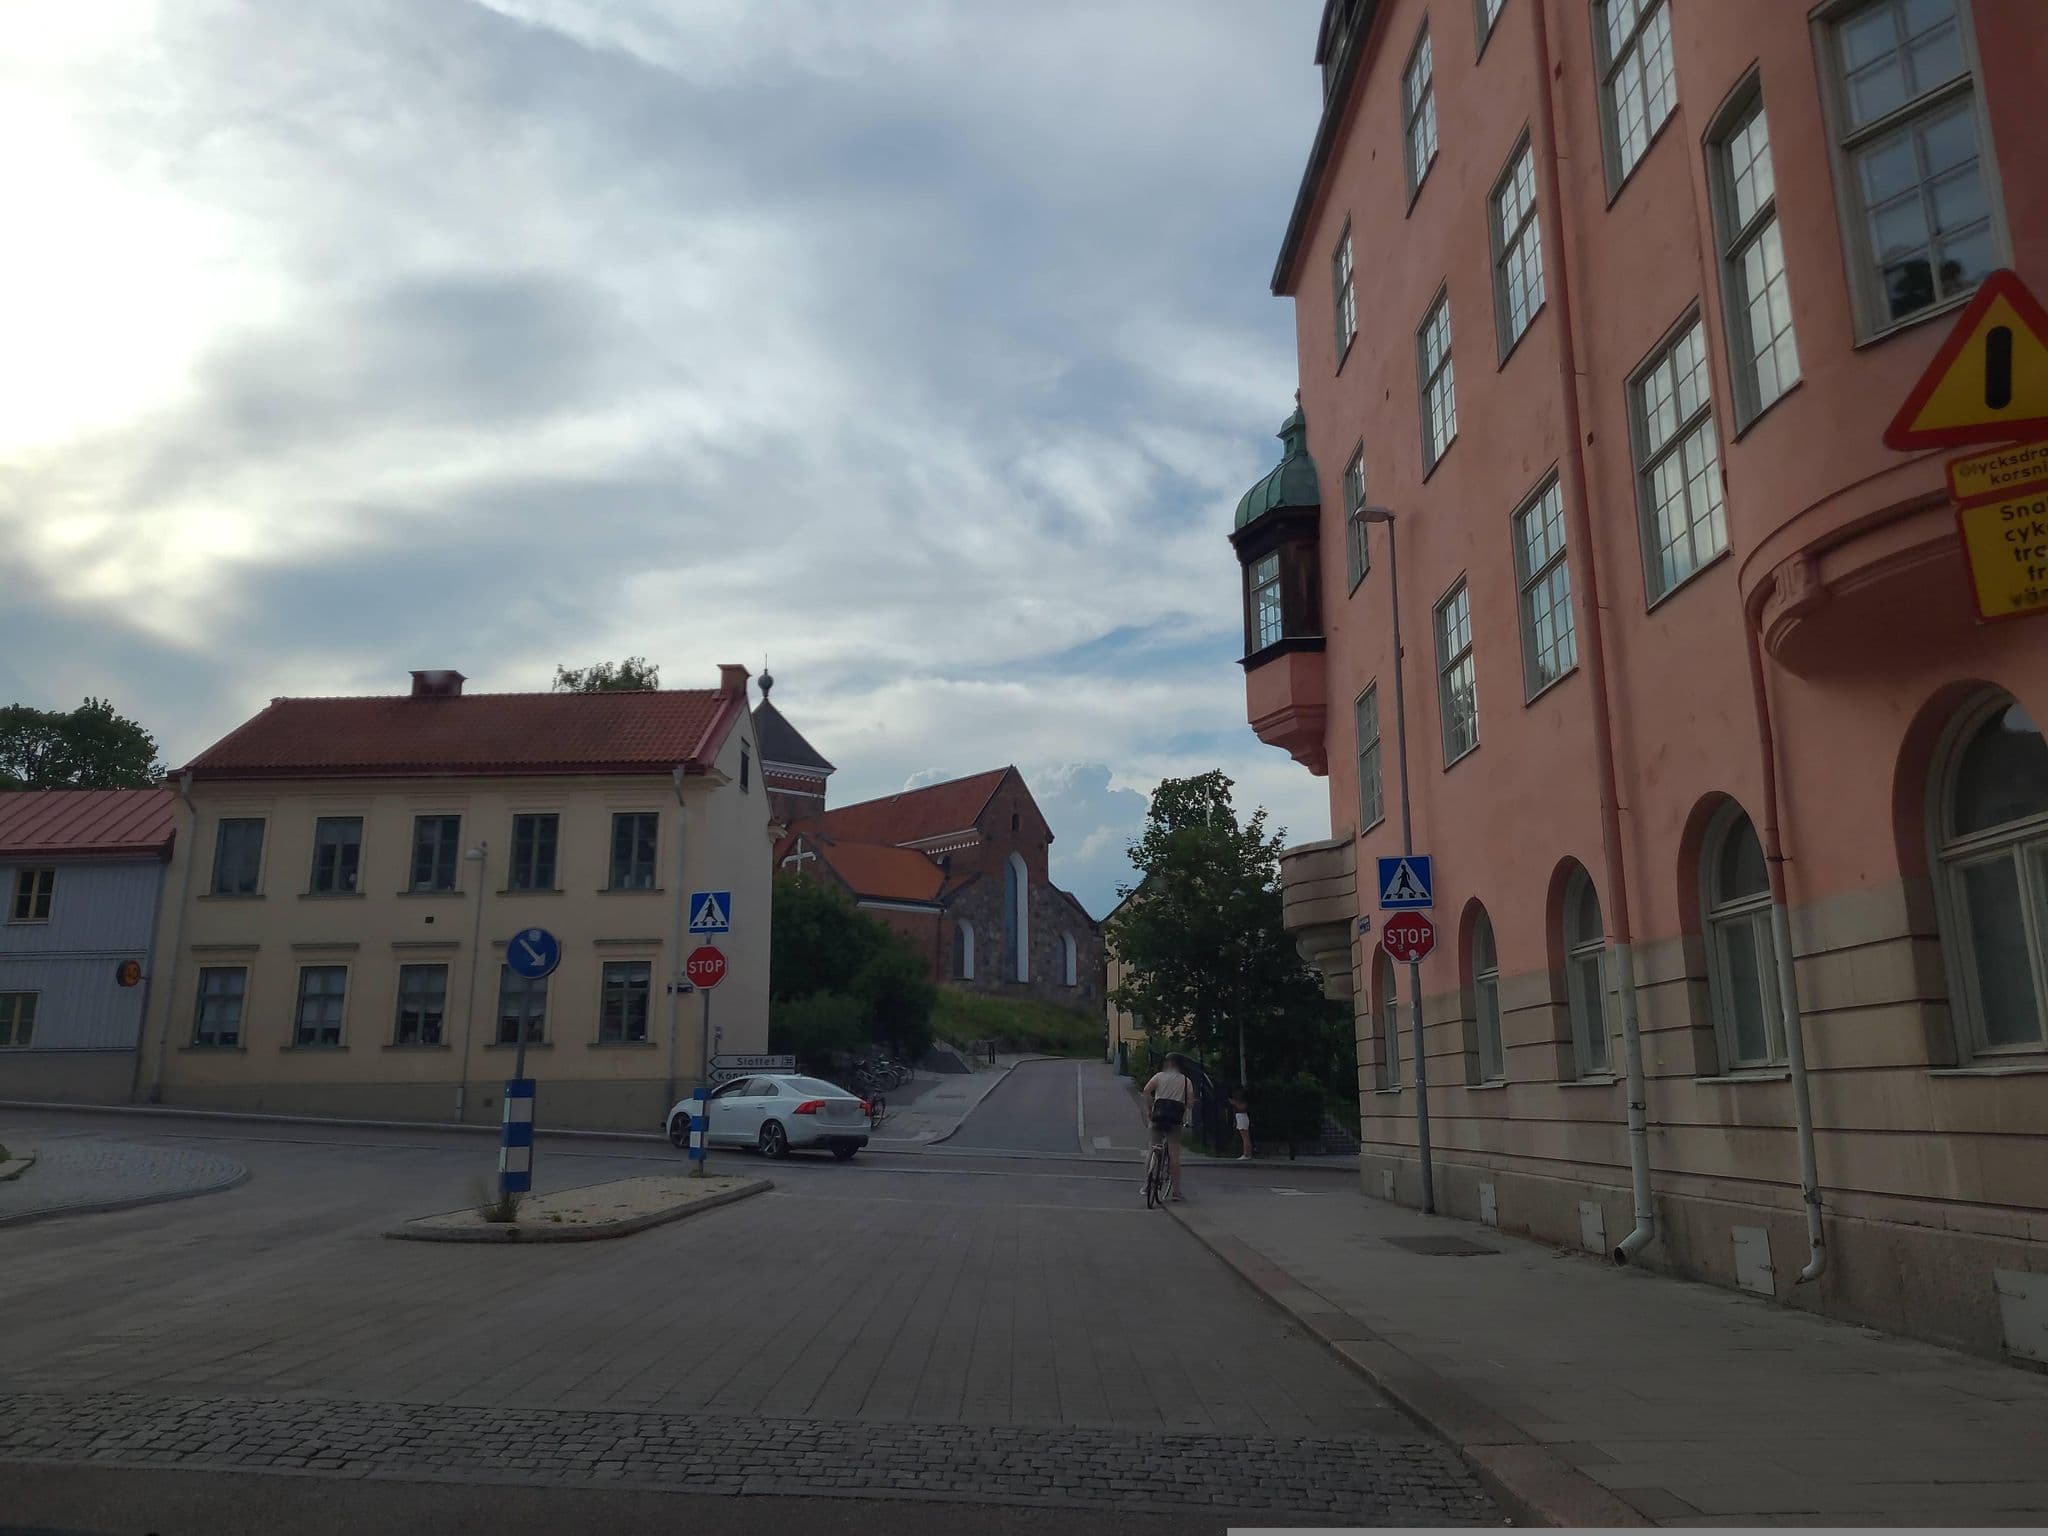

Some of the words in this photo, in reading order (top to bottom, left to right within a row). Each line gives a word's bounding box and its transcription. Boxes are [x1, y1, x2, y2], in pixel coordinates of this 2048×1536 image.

[2000, 498, 2048, 521] Sna
[2004, 520, 2048, 544] cyk
[1386, 928, 1431, 945] STOP
[689, 959, 723, 974] STOP
[736, 1057, 775, 1066] Slottet
